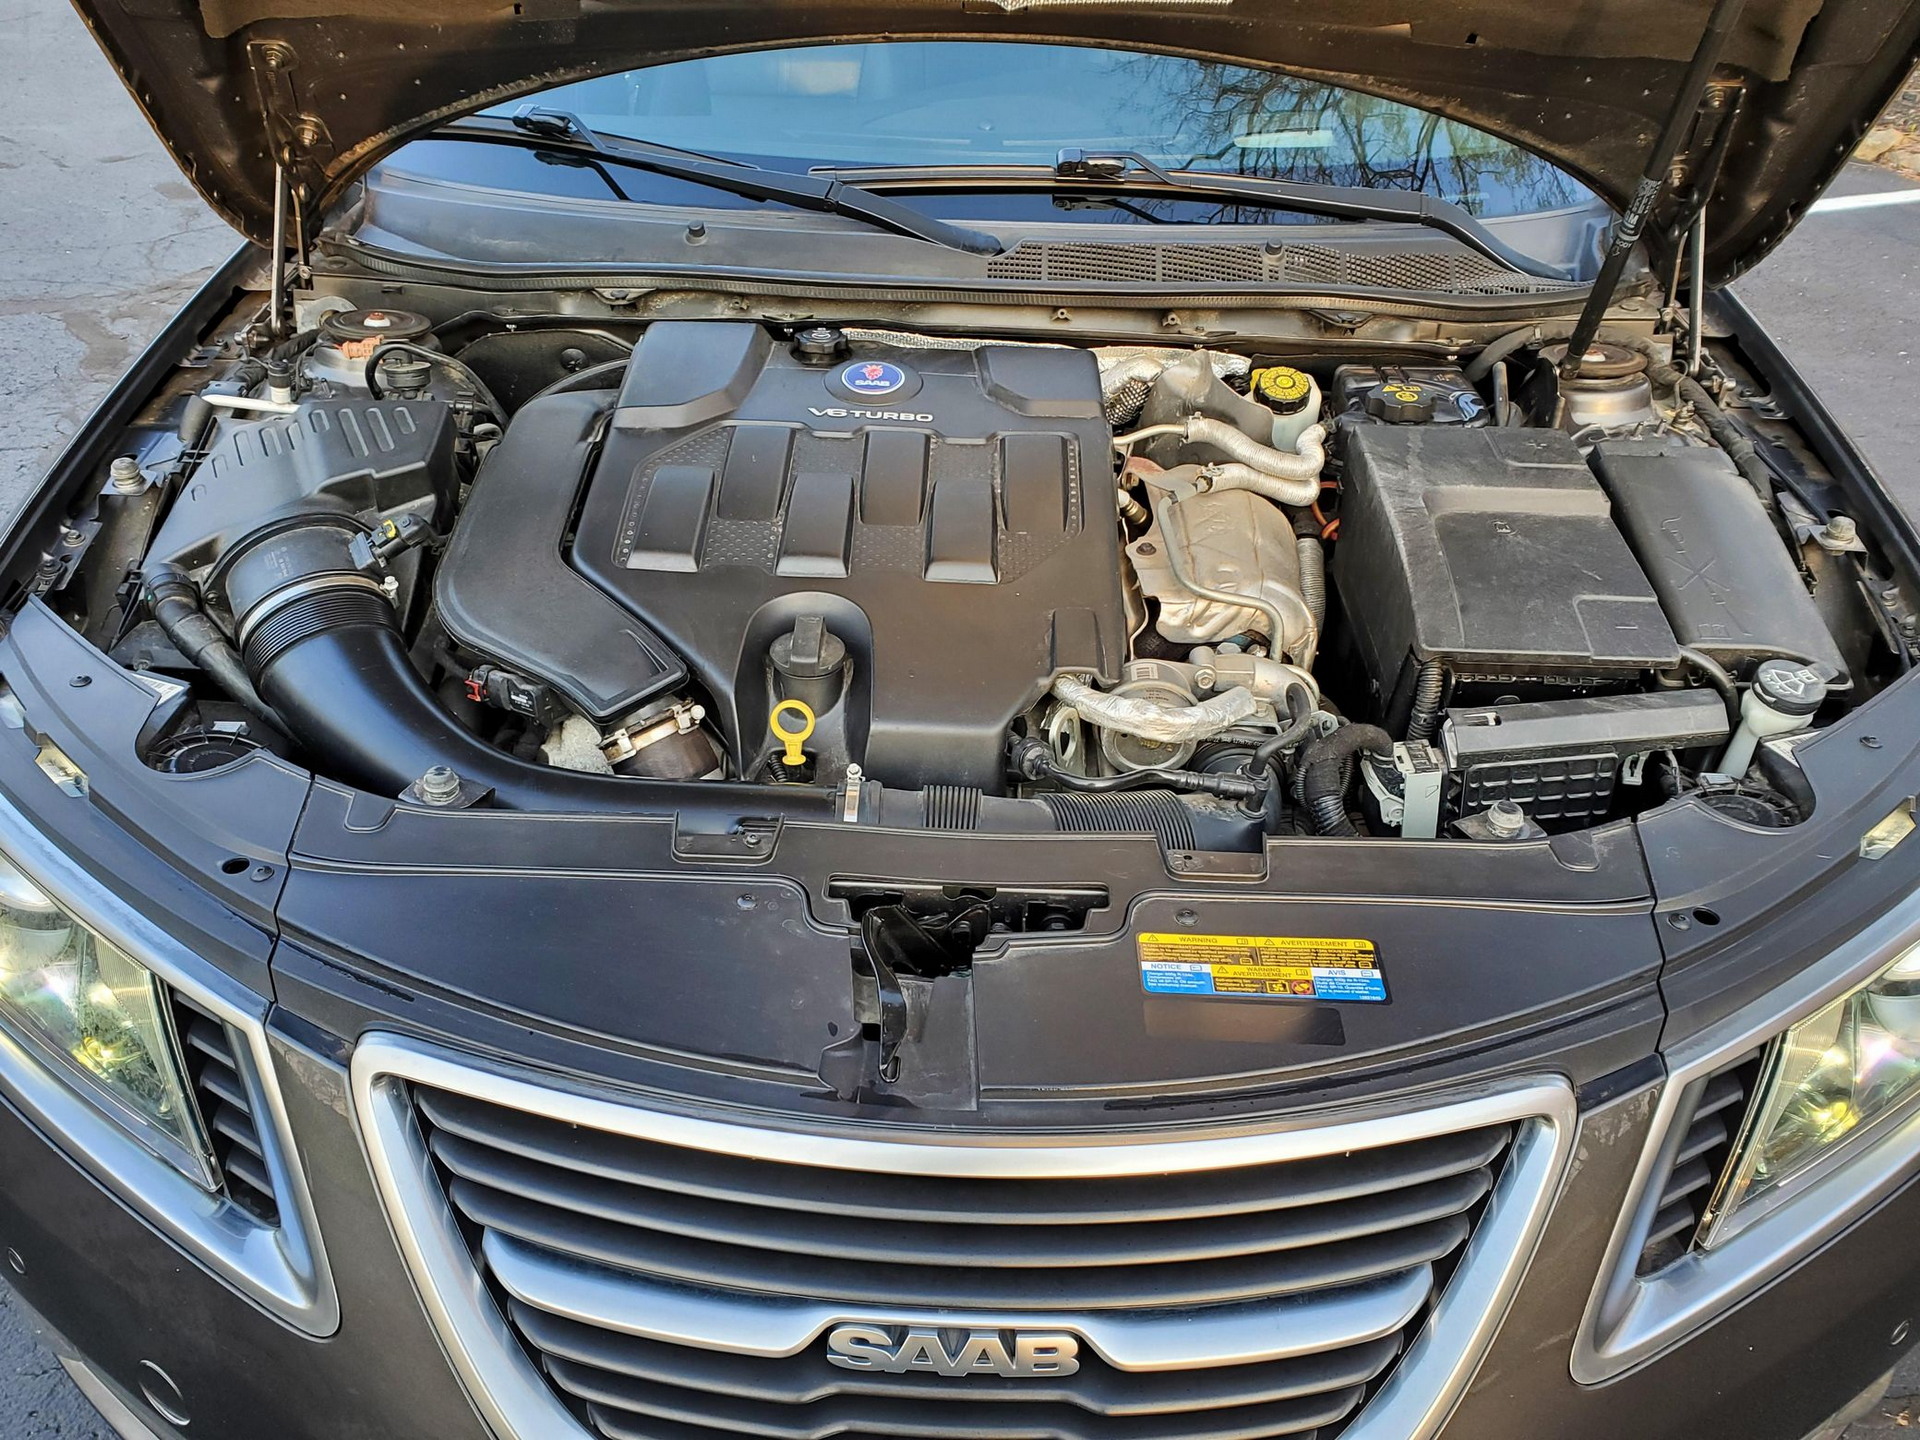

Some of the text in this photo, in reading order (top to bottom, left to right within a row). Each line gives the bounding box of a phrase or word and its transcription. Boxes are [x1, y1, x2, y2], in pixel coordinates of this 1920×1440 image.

[854, 379, 890, 387] SAAB
[808, 407, 934, 422] V6 TURBO
[1178, 936, 1218, 944] WARNING
[1280, 939, 1349, 948] AVERTISSEMENT
[826, 1322, 1081, 1378] SAAB
